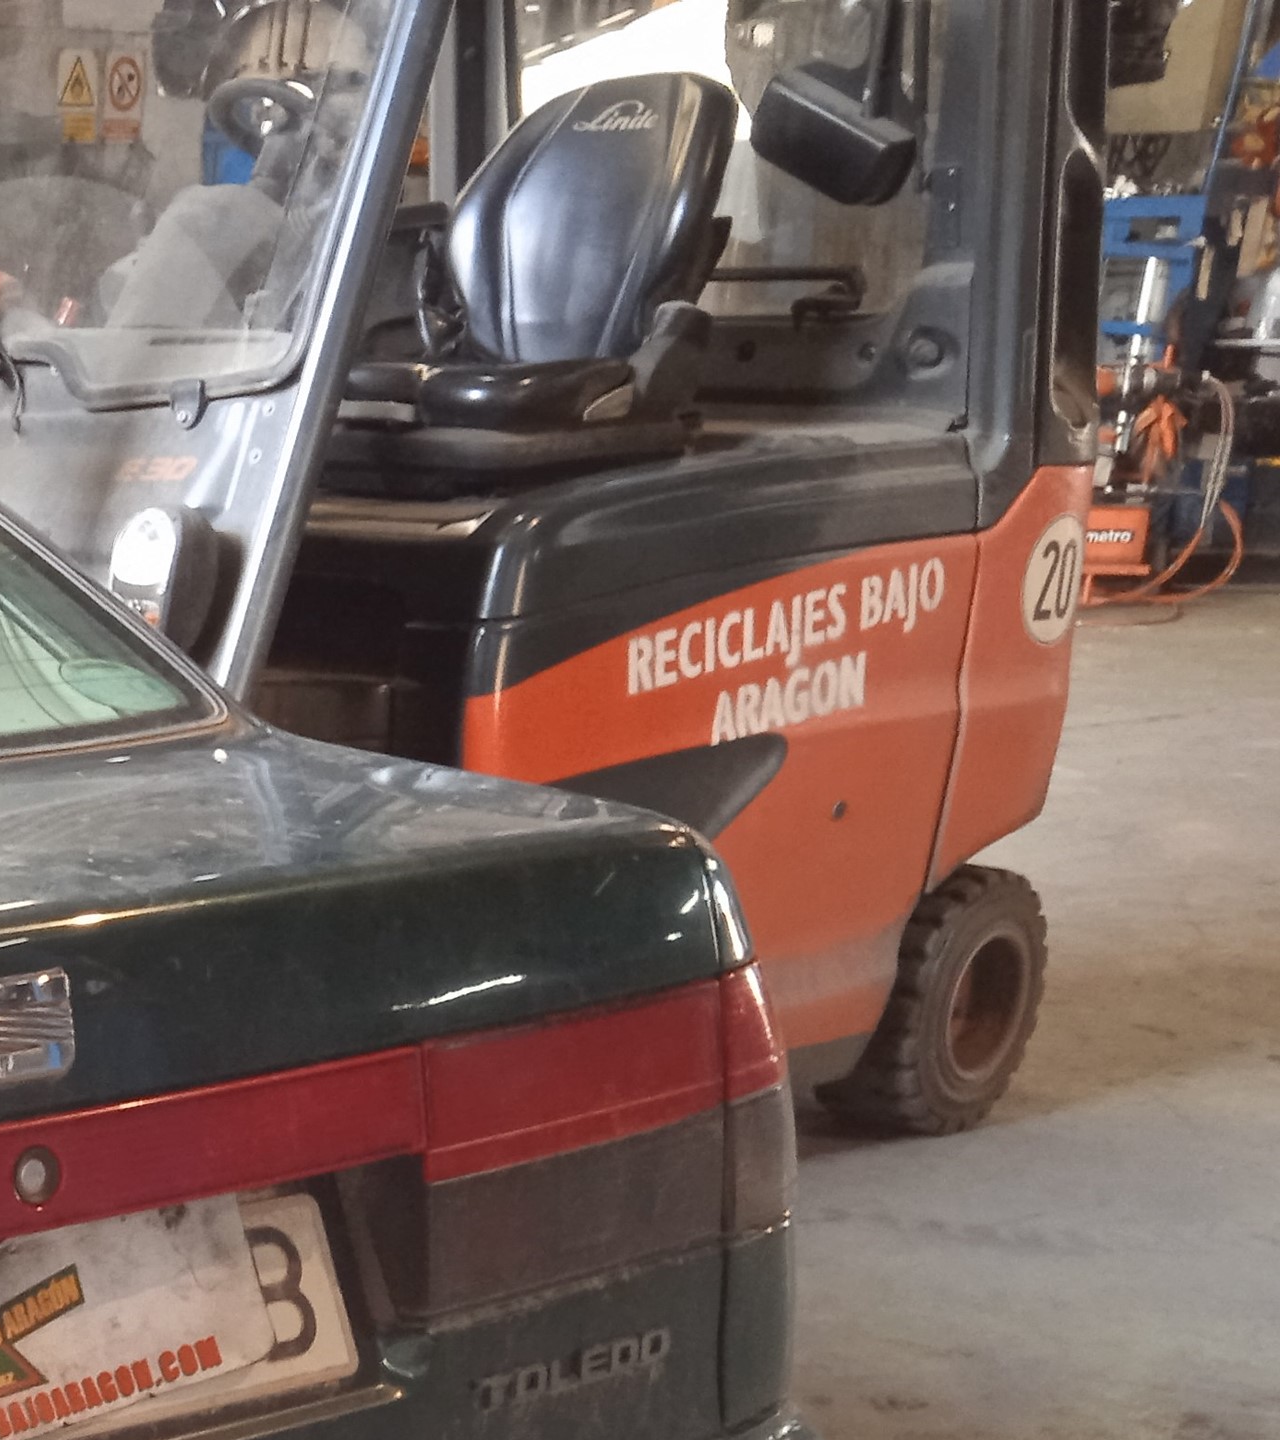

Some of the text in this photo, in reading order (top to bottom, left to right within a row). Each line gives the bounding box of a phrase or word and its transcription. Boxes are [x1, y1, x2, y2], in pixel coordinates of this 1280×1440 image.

[573, 100, 659, 132] Linde
[1032, 539, 1077, 621] 20
[627, 557, 945, 696] RECICLAJES BAJO
[710, 651, 867, 747] ARAGON
[244, 1226, 317, 1362] B
[479, 1328, 671, 1413] TOLEDO
